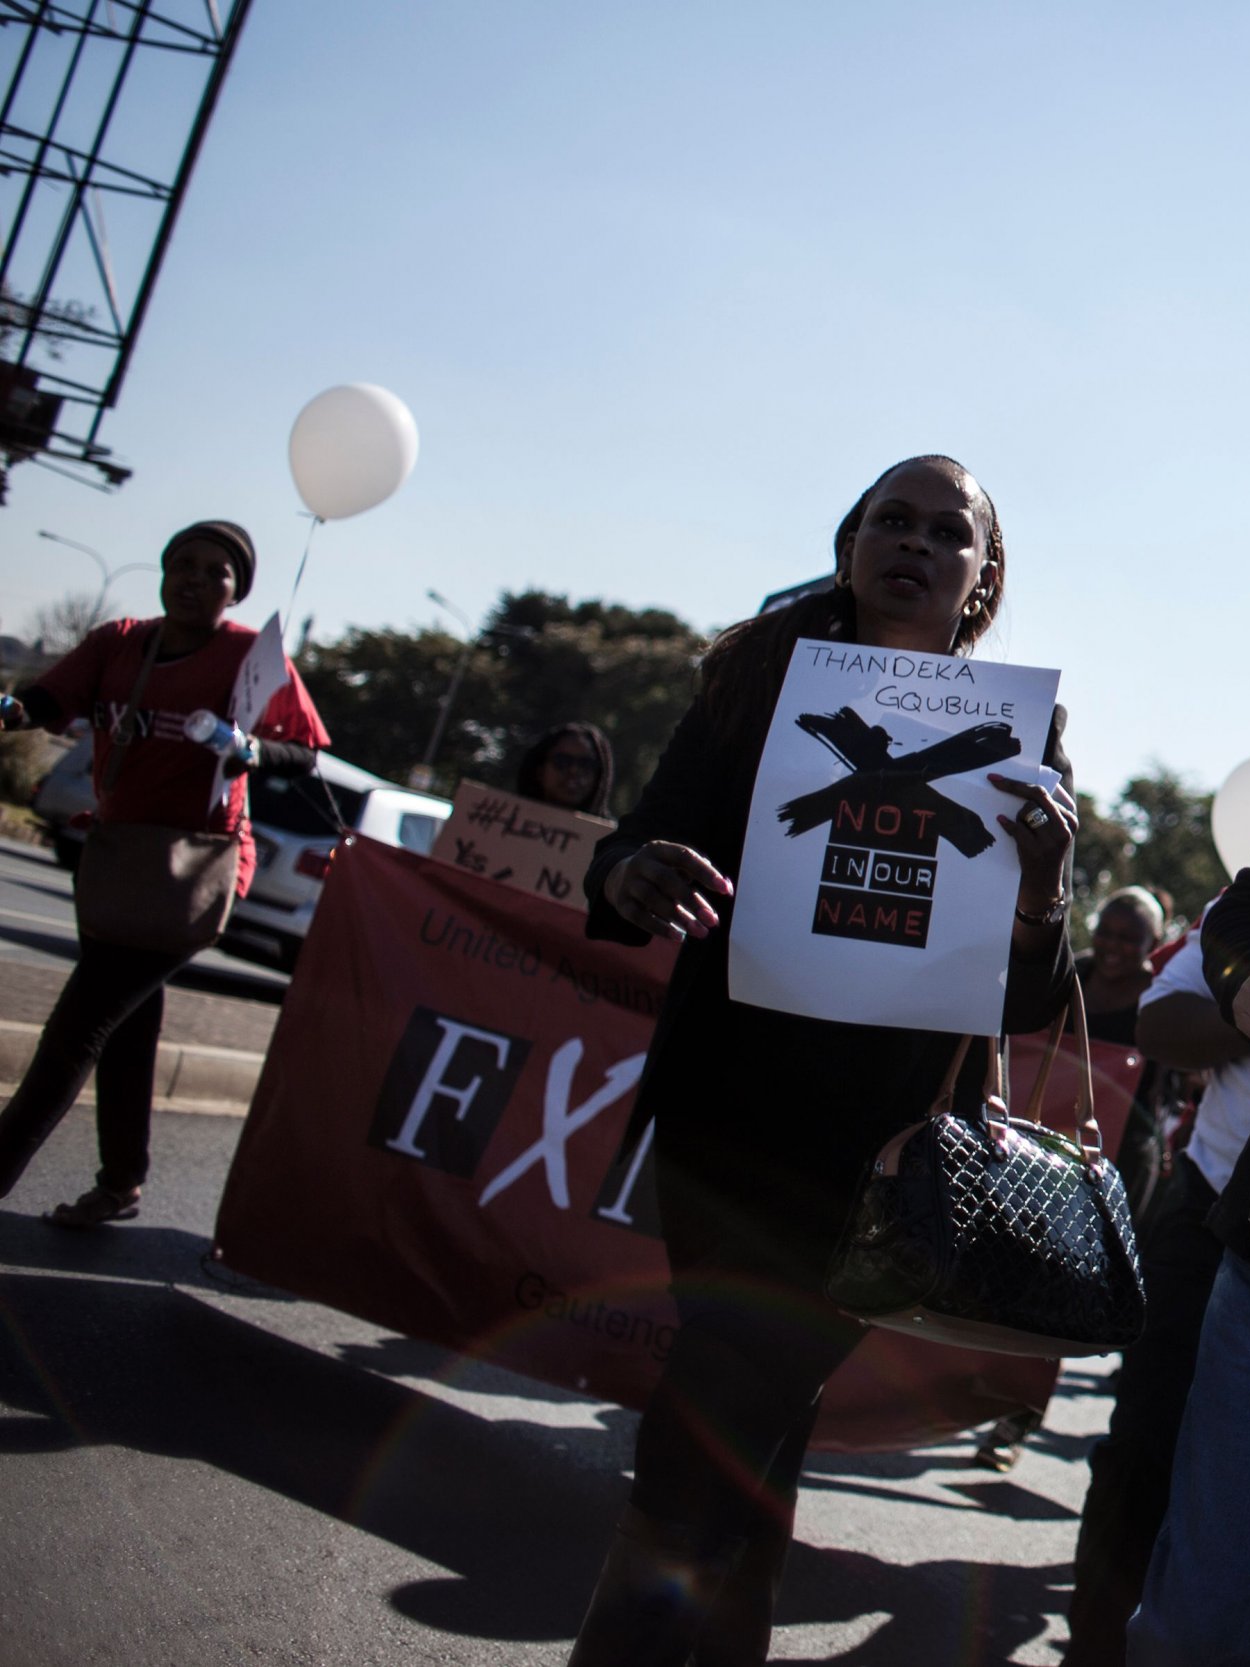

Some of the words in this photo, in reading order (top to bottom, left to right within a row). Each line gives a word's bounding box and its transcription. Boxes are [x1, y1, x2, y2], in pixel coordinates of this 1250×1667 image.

[806, 646, 975, 684] THANDEKA
[875, 686, 1015, 719] GQUBULE
[836, 800, 936, 839] NOT
[831, 856, 866, 876] IN
[874, 862, 932, 888] OUR
[817, 899, 925, 937] NAME
[419, 907, 543, 977] United
[550, 954, 668, 1017] Again
[513, 1271, 675, 1363] Gauteng
